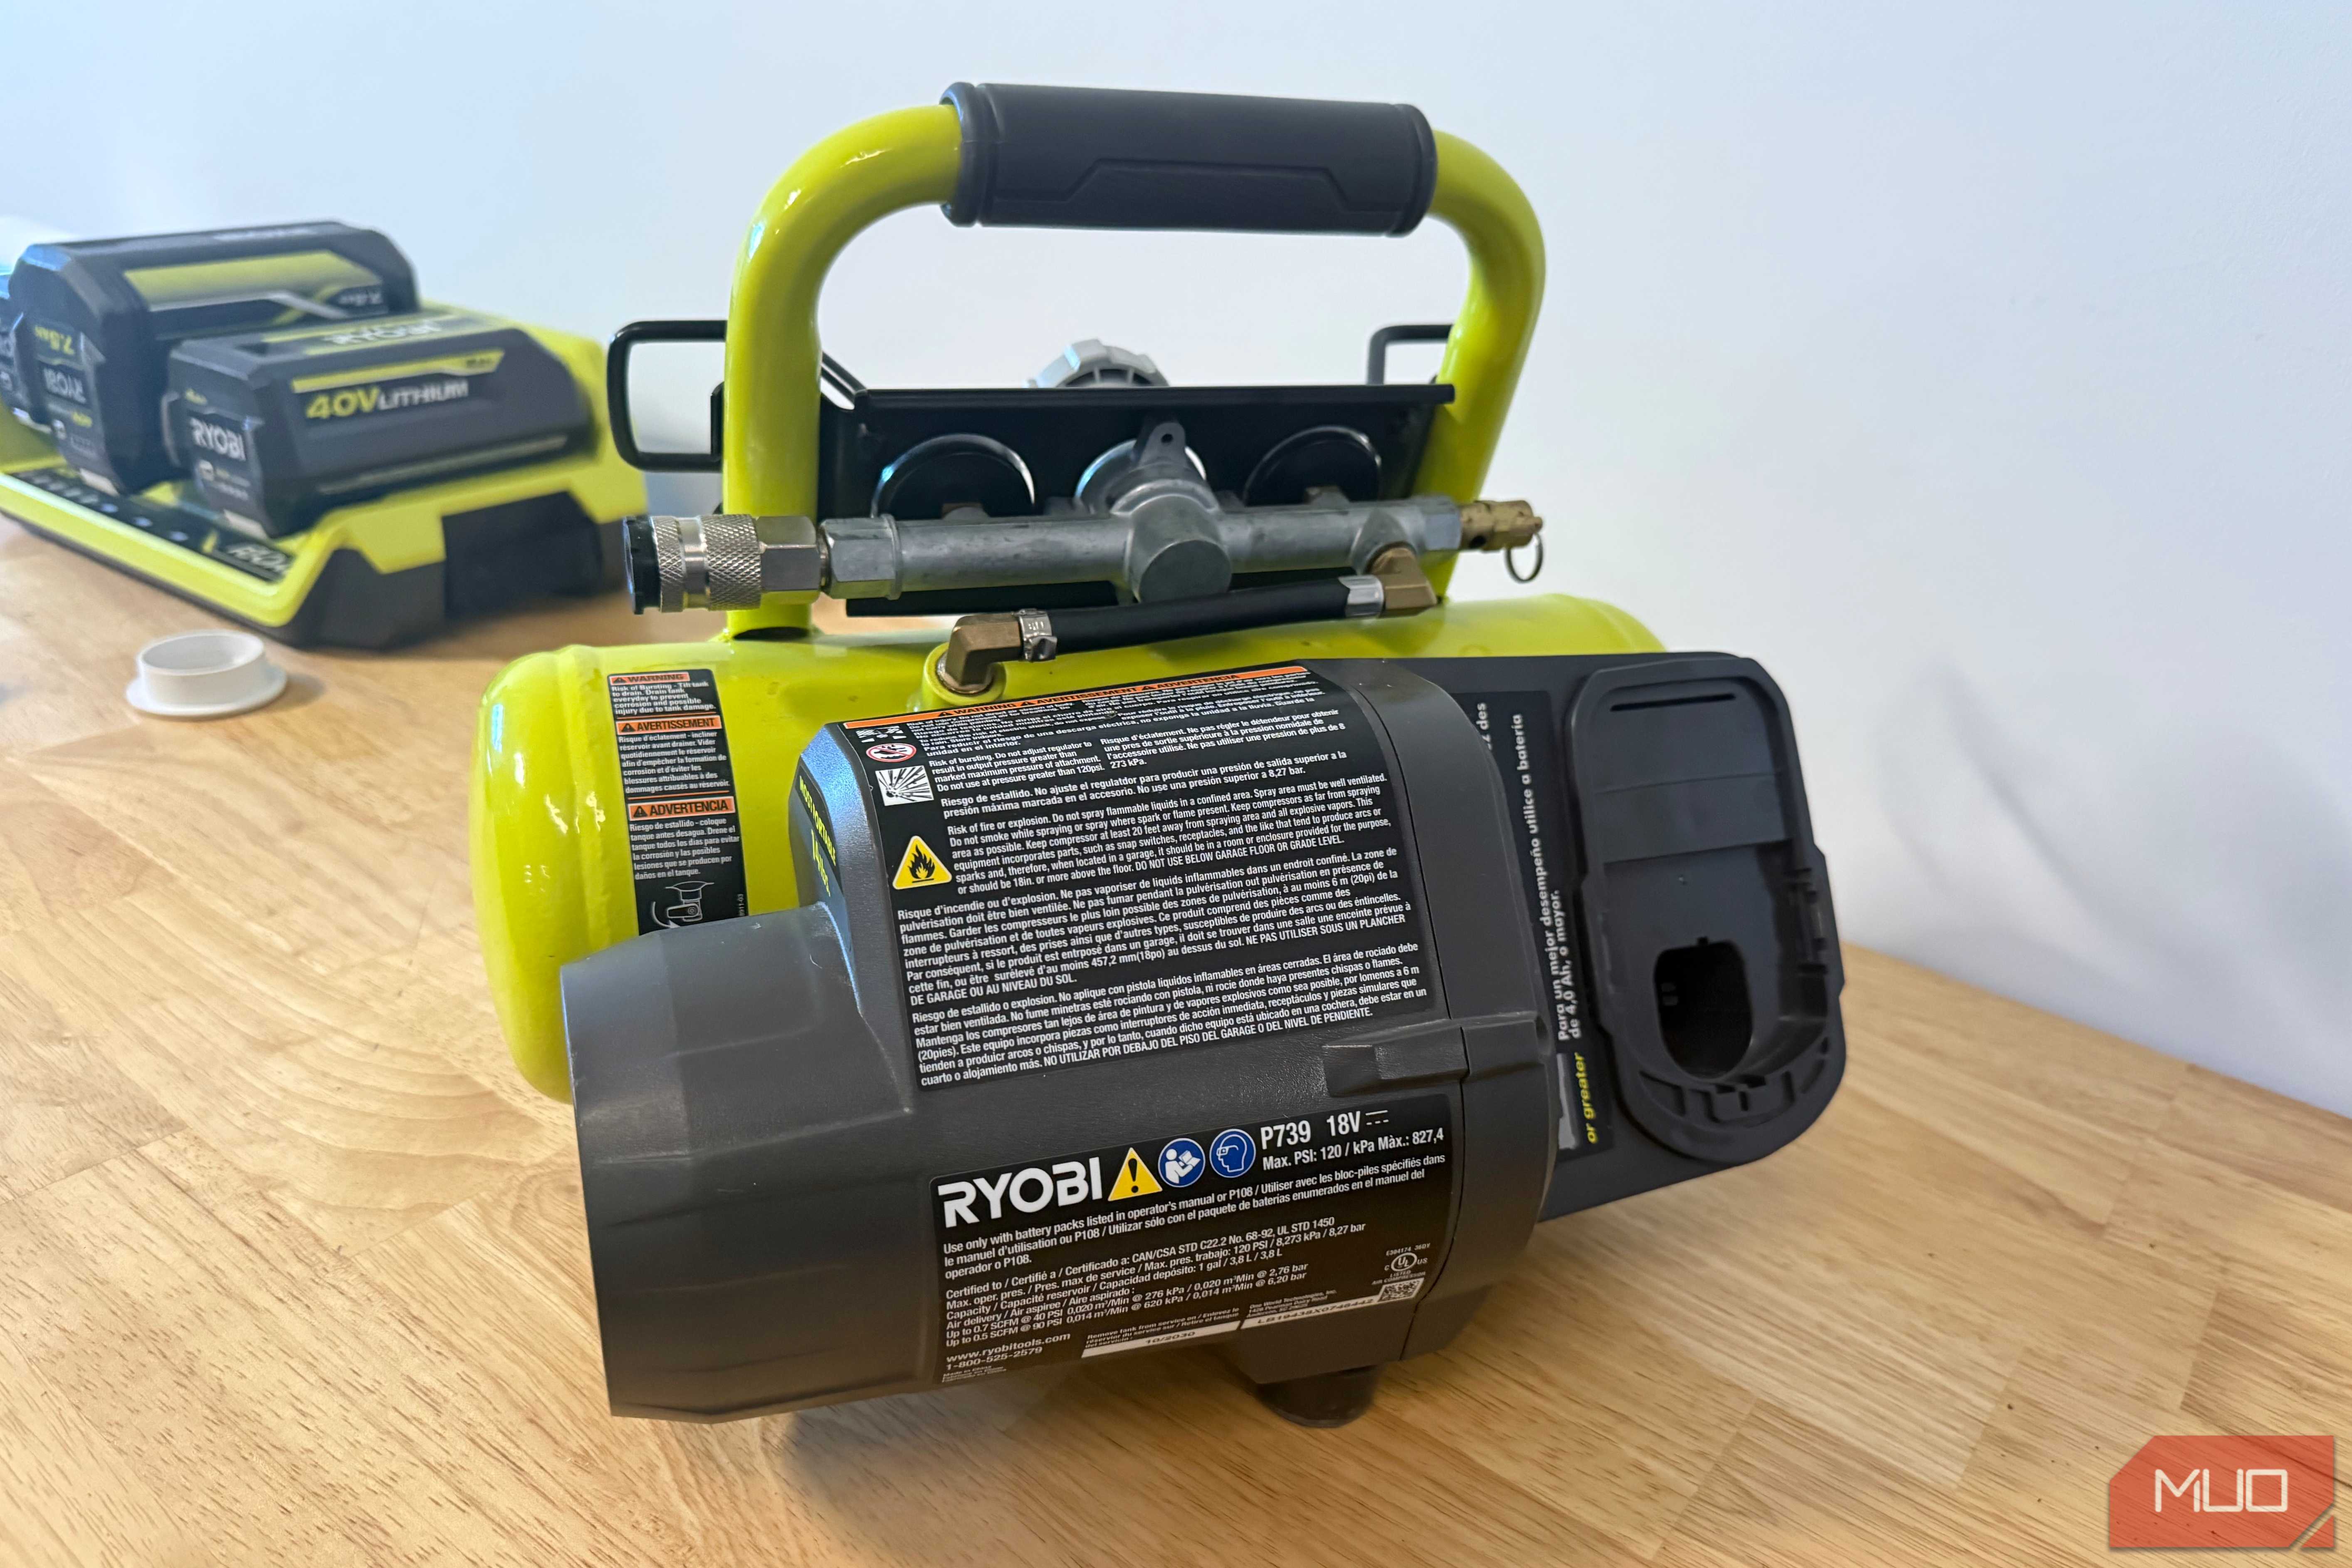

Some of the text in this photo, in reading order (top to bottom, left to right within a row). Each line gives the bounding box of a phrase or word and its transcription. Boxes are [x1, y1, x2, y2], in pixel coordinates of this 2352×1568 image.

[190, 417, 246, 461] RYOBI
[628, 674, 684, 682] WARNING
[1157, 675, 1239, 688] ADVERTENCIA
[954, 703, 1016, 714] WARNING
[1037, 687, 1136, 704] AVERTISSEMENT
[637, 717, 714, 731] AVERTISSEMENT
[1476, 703, 1489, 730] des
[957, 755, 994, 763] bursting.
[1022, 746, 1047, 755] adjust
[1047, 743, 1082, 752] regulator
[1521, 774, 1531, 785] a
[650, 799, 729, 816] ADVERTENCIA
[947, 825, 968, 835] Risk
[968, 822, 978, 833] of
[979, 822, 995, 832] fire
[1008, 815, 1051, 829] explosion.
[1052, 813, 1064, 822] Do
[1065, 811, 1080, 821] not
[1081, 809, 1104, 820] spray
[1105, 803, 1149, 816] flammable
[1150, 799, 1178, 811] liquids
[1179, 798, 1188, 807] in
[1196, 792, 1231, 805] confined
[1232, 791, 1253, 800] area.
[1253, 788, 1276, 799] Spray
[1277, 785, 1296, 794] area
[1297, 781, 1317, 792] must
[1317, 780, 1328, 789] be
[1329, 778, 1346, 788] well
[1346, 773, 1387, 785] ventilated.
[1523, 789, 1538, 834] utilice
[630, 833, 655, 842] tanque
[675, 829, 707, 837] desagua.
[664, 819, 694, 829] estallido
[699, 817, 726, 826] coloque
[631, 843, 655, 852] tanque
[656, 840, 676, 848] todos
[704, 837, 720, 846] para
[720, 835, 740, 843] evitar
[692, 846, 721, 857] posibles
[664, 861, 677, 869] que
[687, 857, 720, 867] producen
[720, 856, 732, 864] por
[667, 869, 674, 877] el
[674, 869, 701, 877] tanque.
[1530, 838, 1552, 926] desempeño
[1544, 930, 1561, 975] mejor
[1550, 890, 1580, 1038] de 4,0 Ah, o mayor.
[1552, 978, 1565, 999] un
[1556, 1003, 1569, 1040] Para
[1574, 1052, 1597, 1143] or greater
[1260, 1110, 1360, 1149] P739 18V
[1262, 1156, 1291, 1170] Max.
[1294, 1148, 1317, 1165] PSI:
[1320, 1144, 1342, 1160] 120
[1353, 1139, 1375, 1154] kPa
[1412, 1127, 1444, 1145] 827,4
[937, 1156, 1102, 1228] RYOBI
[943, 1243, 964, 1254] Use
[965, 1237, 988, 1249] only
[989, 1232, 1013, 1245] with
[1015, 1225, 1051, 1240] battery
[1053, 1219, 1085, 1235] packs
[1087, 1212, 1114, 1227] listed
[1116, 1210, 1125, 1221] in
[1178, 1193, 1215, 1209] manual
[1216, 1193, 1227, 1202] or
[1228, 1186, 1253, 1200] P108
[1261, 1180, 1293, 1194] Utiliser
[1295, 1176, 1317, 1188] avec
[1319, 1173, 1333, 1183] les
[1334, 1165, 1379, 1180] bloc-piles
[1423, 1155, 1445, 1165] dans
[944, 1257, 954, 1267] le
[956, 1247, 995, 1264] manuel
[1059, 1235, 1072, 1245] ou
[1074, 1227, 1100, 1242] P108
[1108, 1221, 1143, 1235] Utilizar
[1144, 1216, 1165, 1228] sólo
[1166, 1213, 1185, 1224] con
[1187, 1209, 1196, 1220] el
[1198, 1203, 1236, 1220] paquete
[1238, 1200, 1250, 1210] de
[1292, 1183, 1349, 1200] enumerados
[1351, 1180, 1363, 1190] en
[1364, 1177, 1373, 1188] el
[1375, 1170, 1408, 1186] manuel
[1411, 1168, 1424, 1180] del
[945, 1254, 1032, 1280] operador o P108.
[946, 1282, 989, 1299] Certified
[991, 1281, 1002, 1290] to
[1011, 1270, 1047, 1286] Certifié
[1065, 1258, 1119, 1276] Certificado
[1120, 1257, 1130, 1265] a:
[1132, 1246, 1176, 1263] CAN/CSA
[1178, 1242, 1198, 1254] STD
[1200, 1236, 1227, 1249] C22.2
[1228, 1235, 1244, 1245] No.
[1245, 1228, 1275, 1241] 68-92,
[1277, 1225, 1290, 1235] UL
[1291, 1221, 1310, 1233] STD
[1312, 1216, 1334, 1229] 1450
[946, 1333, 1070, 1362] www.ryobitools.com
[946, 1346, 1043, 1370] 1-800-525-2579
